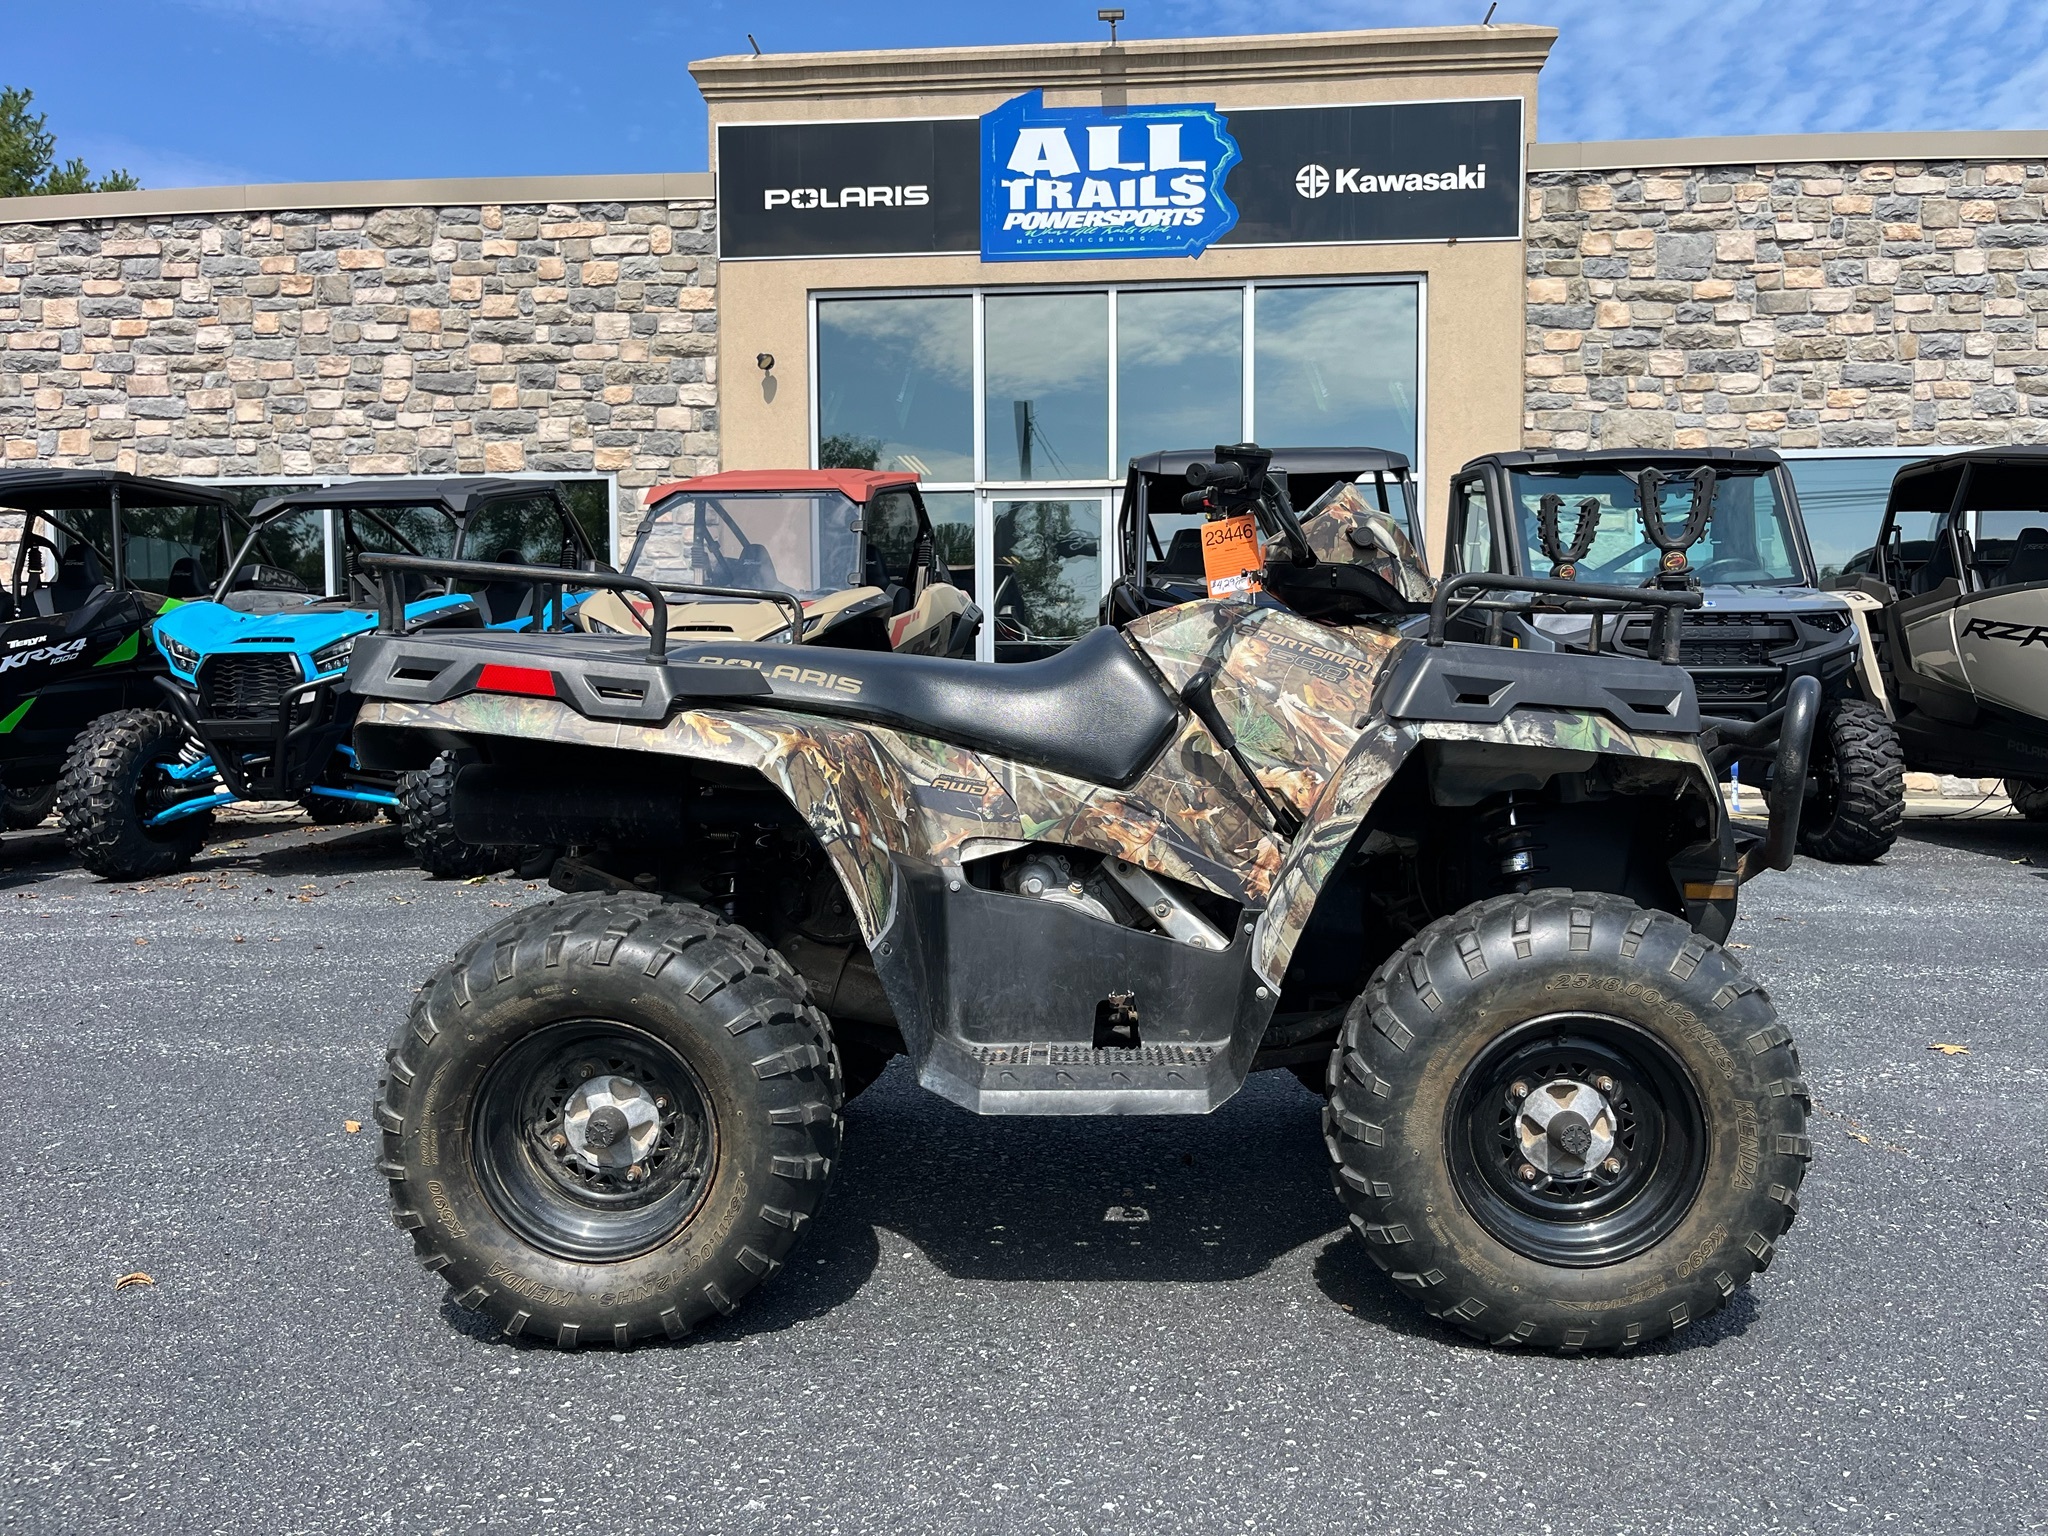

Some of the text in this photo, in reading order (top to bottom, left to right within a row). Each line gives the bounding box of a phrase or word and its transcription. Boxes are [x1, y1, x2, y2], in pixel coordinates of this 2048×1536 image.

[1006, 124, 1207, 178] ALL
[1001, 174, 1207, 210] TRAILS
[1335, 164, 1486, 194] Kawasaki
[764, 185, 930, 210] POLARIS
[1002, 207, 1206, 231] POWERSPORTS
[1205, 523, 1254, 547] 23446
[49, 652, 80, 666] 1000
[1238, 624, 1374, 674] SPORTSMAN
[1266, 647, 1350, 681] 500
[931, 778, 989, 796] AWD
[1734, 1098, 1759, 1191] KENDA
[426, 1180, 468, 1240] K590
[1676, 1223, 1729, 1280] K590
[486, 1260, 576, 1308] KENDA
